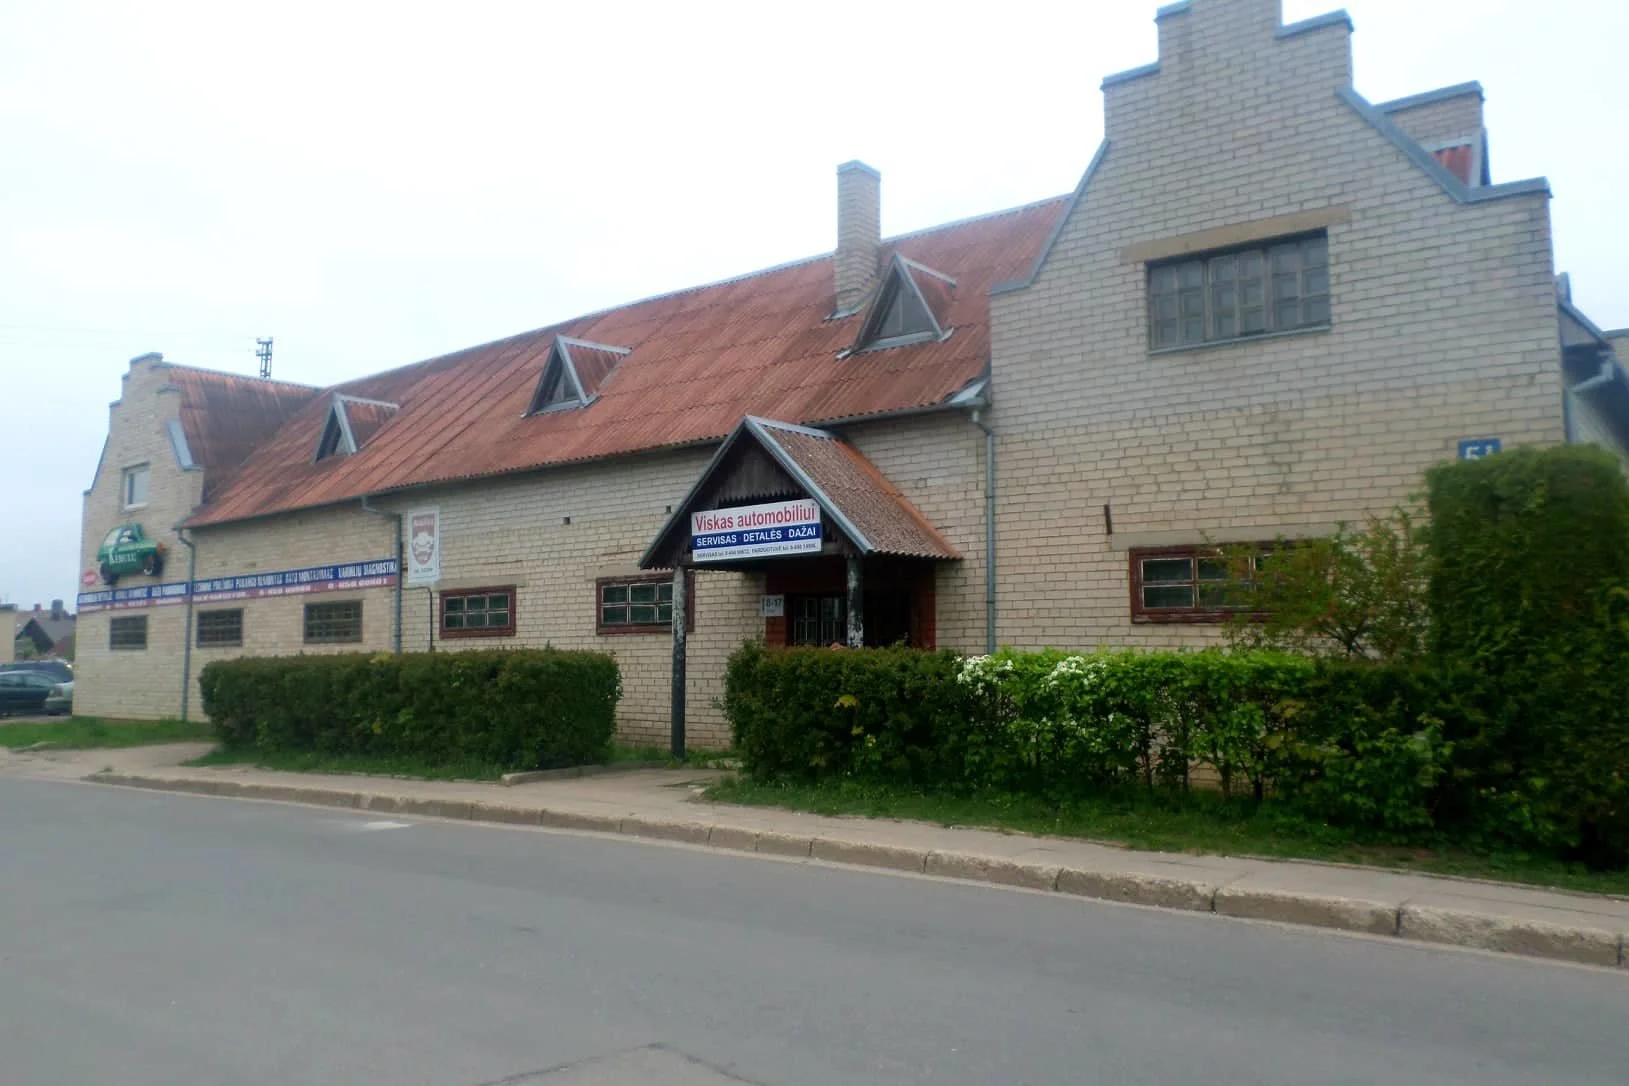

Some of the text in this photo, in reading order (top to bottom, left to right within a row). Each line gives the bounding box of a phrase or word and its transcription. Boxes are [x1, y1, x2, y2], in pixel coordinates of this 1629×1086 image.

[695, 503, 816, 532] Viskas automobiliui
[696, 526, 816, 547] SERVISAS DETALĖS DAŽAI
